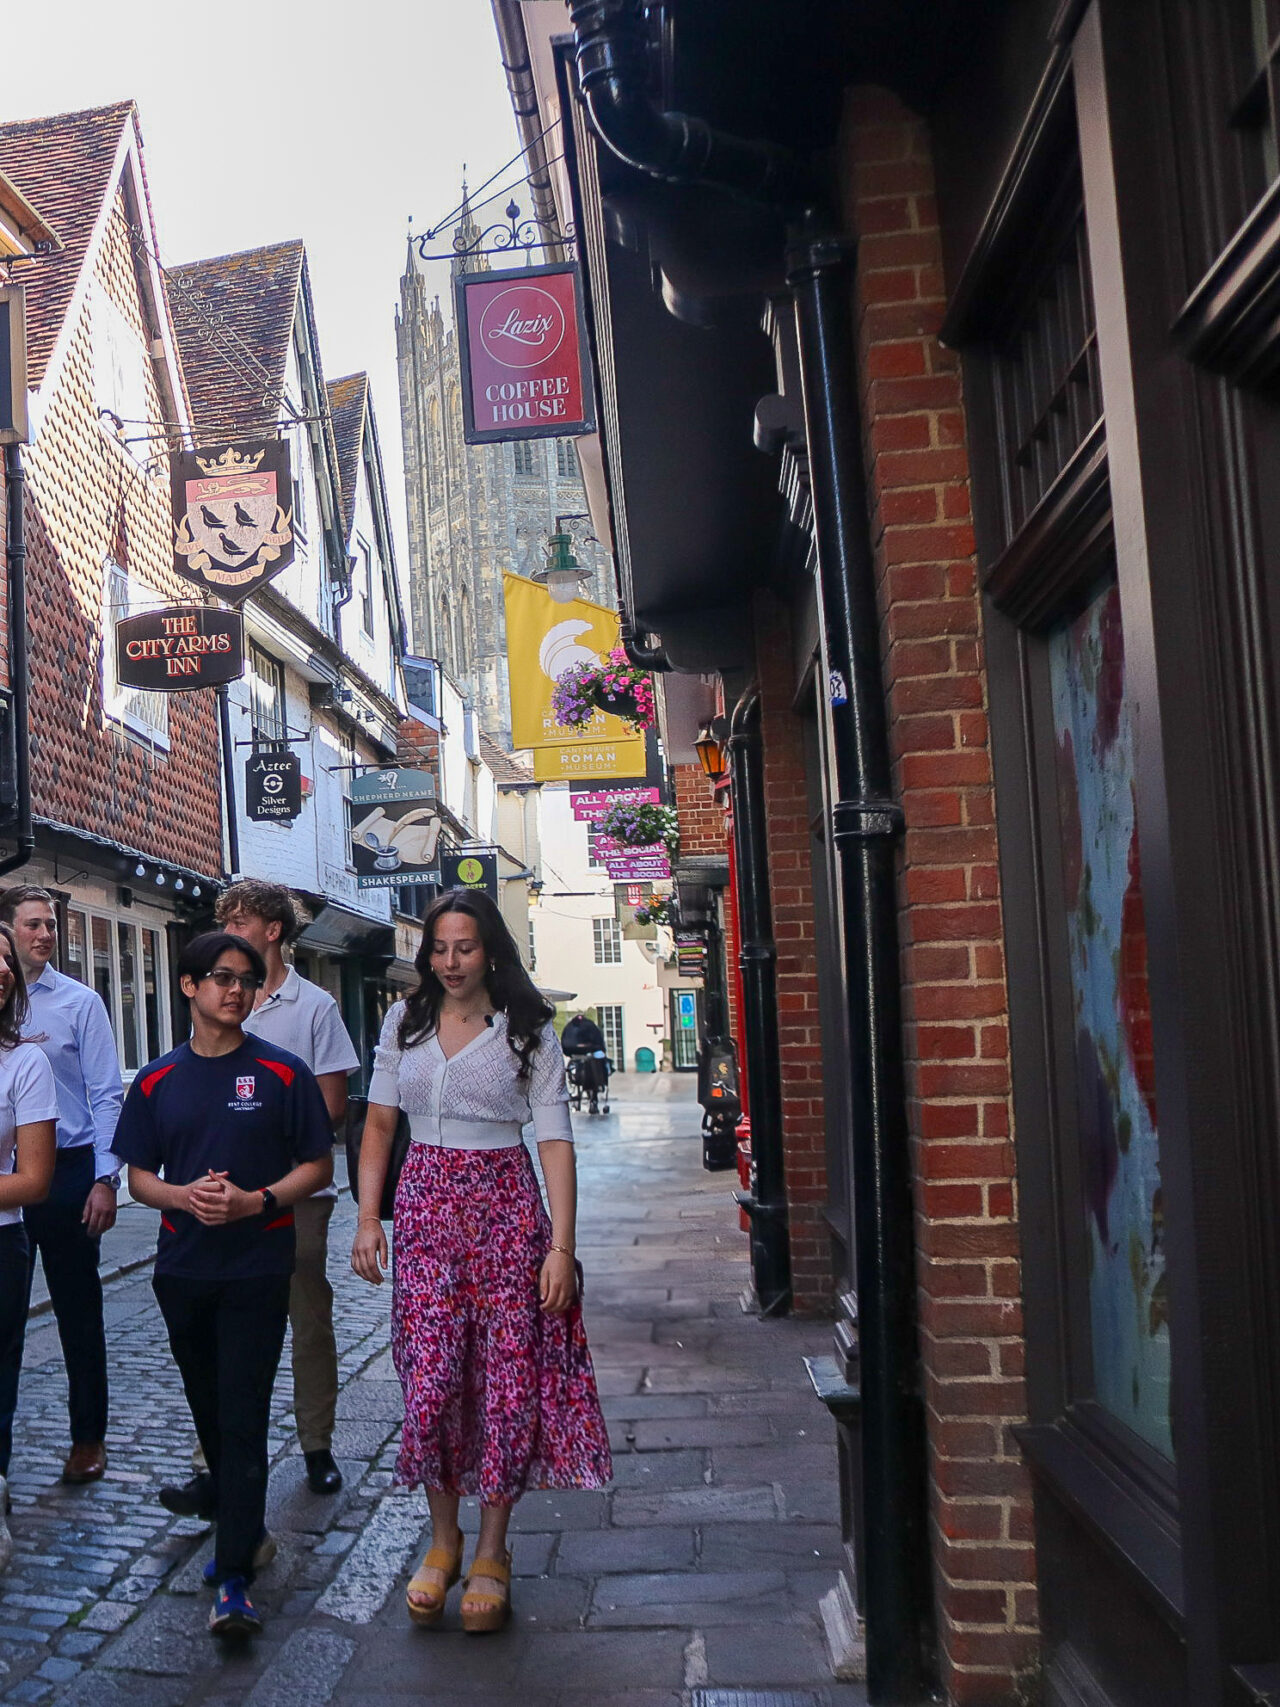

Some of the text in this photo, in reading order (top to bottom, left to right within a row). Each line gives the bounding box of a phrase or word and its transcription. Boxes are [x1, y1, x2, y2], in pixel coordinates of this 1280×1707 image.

[488, 308, 554, 346] Lazix
[485, 376, 570, 402] COFFEE
[492, 398, 567, 422] HOUSE
[215, 570, 254, 584] MATER
[162, 616, 198, 636] THE
[126, 633, 231, 660] CITY ARMS
[165, 656, 202, 677] INN
[560, 745, 616, 754] CANTERBURY
[560, 753, 616, 764] ROMAN
[252, 759, 292, 772] Aztec
[261, 796, 287, 806] Silver
[353, 789, 433, 802] SHEPHERD NEAME
[576, 796, 601, 805] ALL
[257, 805, 291, 815] Designs
[598, 849, 621, 857] THE
[630, 860, 662, 868] ABOUT
[361, 873, 436, 887] SHAKESPEARE
